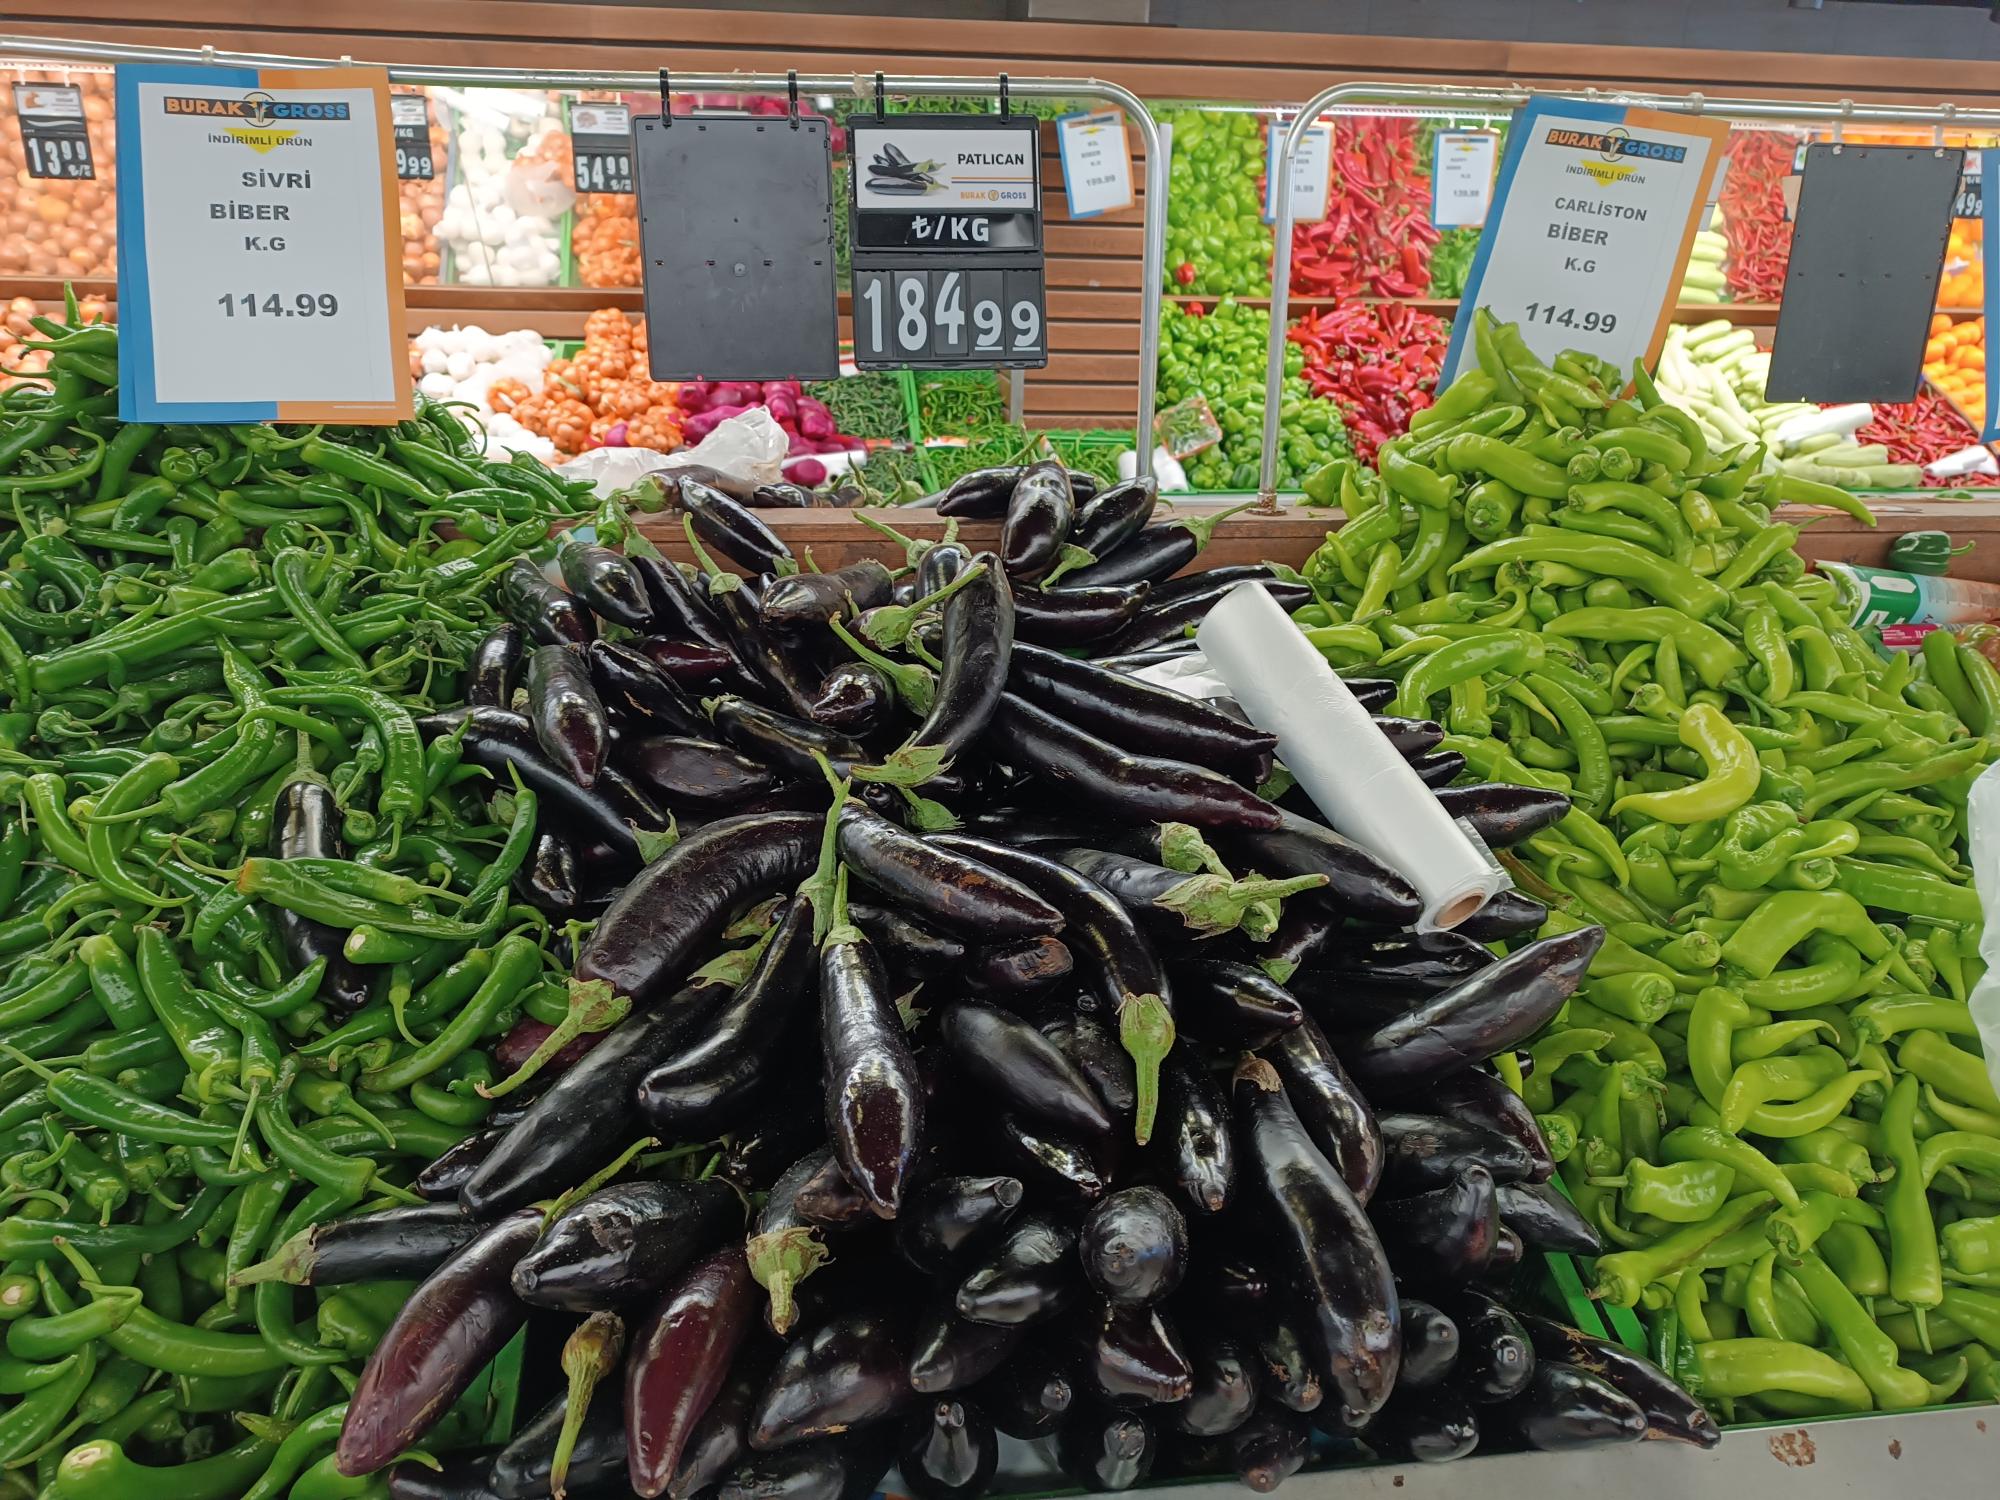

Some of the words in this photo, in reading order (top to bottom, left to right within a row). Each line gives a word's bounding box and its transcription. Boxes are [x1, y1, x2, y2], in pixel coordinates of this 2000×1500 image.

[165, 97, 246, 117] BURAK
[272, 103, 348, 119] GROSS
[207, 132, 273, 147] İNDİRİMLİ
[276, 135, 314, 148] ÜRÜN
[1548, 130, 1604, 150] BURAK
[1624, 140, 1685, 162] GROSS
[957, 153, 1025, 166] PATLICAN
[241, 168, 312, 189] SİVRİ
[1565, 163, 1615, 180] İNDİRİMLİ
[960, 191, 987, 200] BURAK
[1000, 191, 1027, 200] GROSS
[209, 200, 291, 221] BİBER
[1554, 197, 1648, 222] CARLİSTON
[244, 236, 286, 252] K.G
[1547, 221, 1609, 246] BİBER
[1564, 256, 1597, 273] K.G
[218, 292, 339, 318] 114.99
[1525, 302, 1618, 334] 114.99
